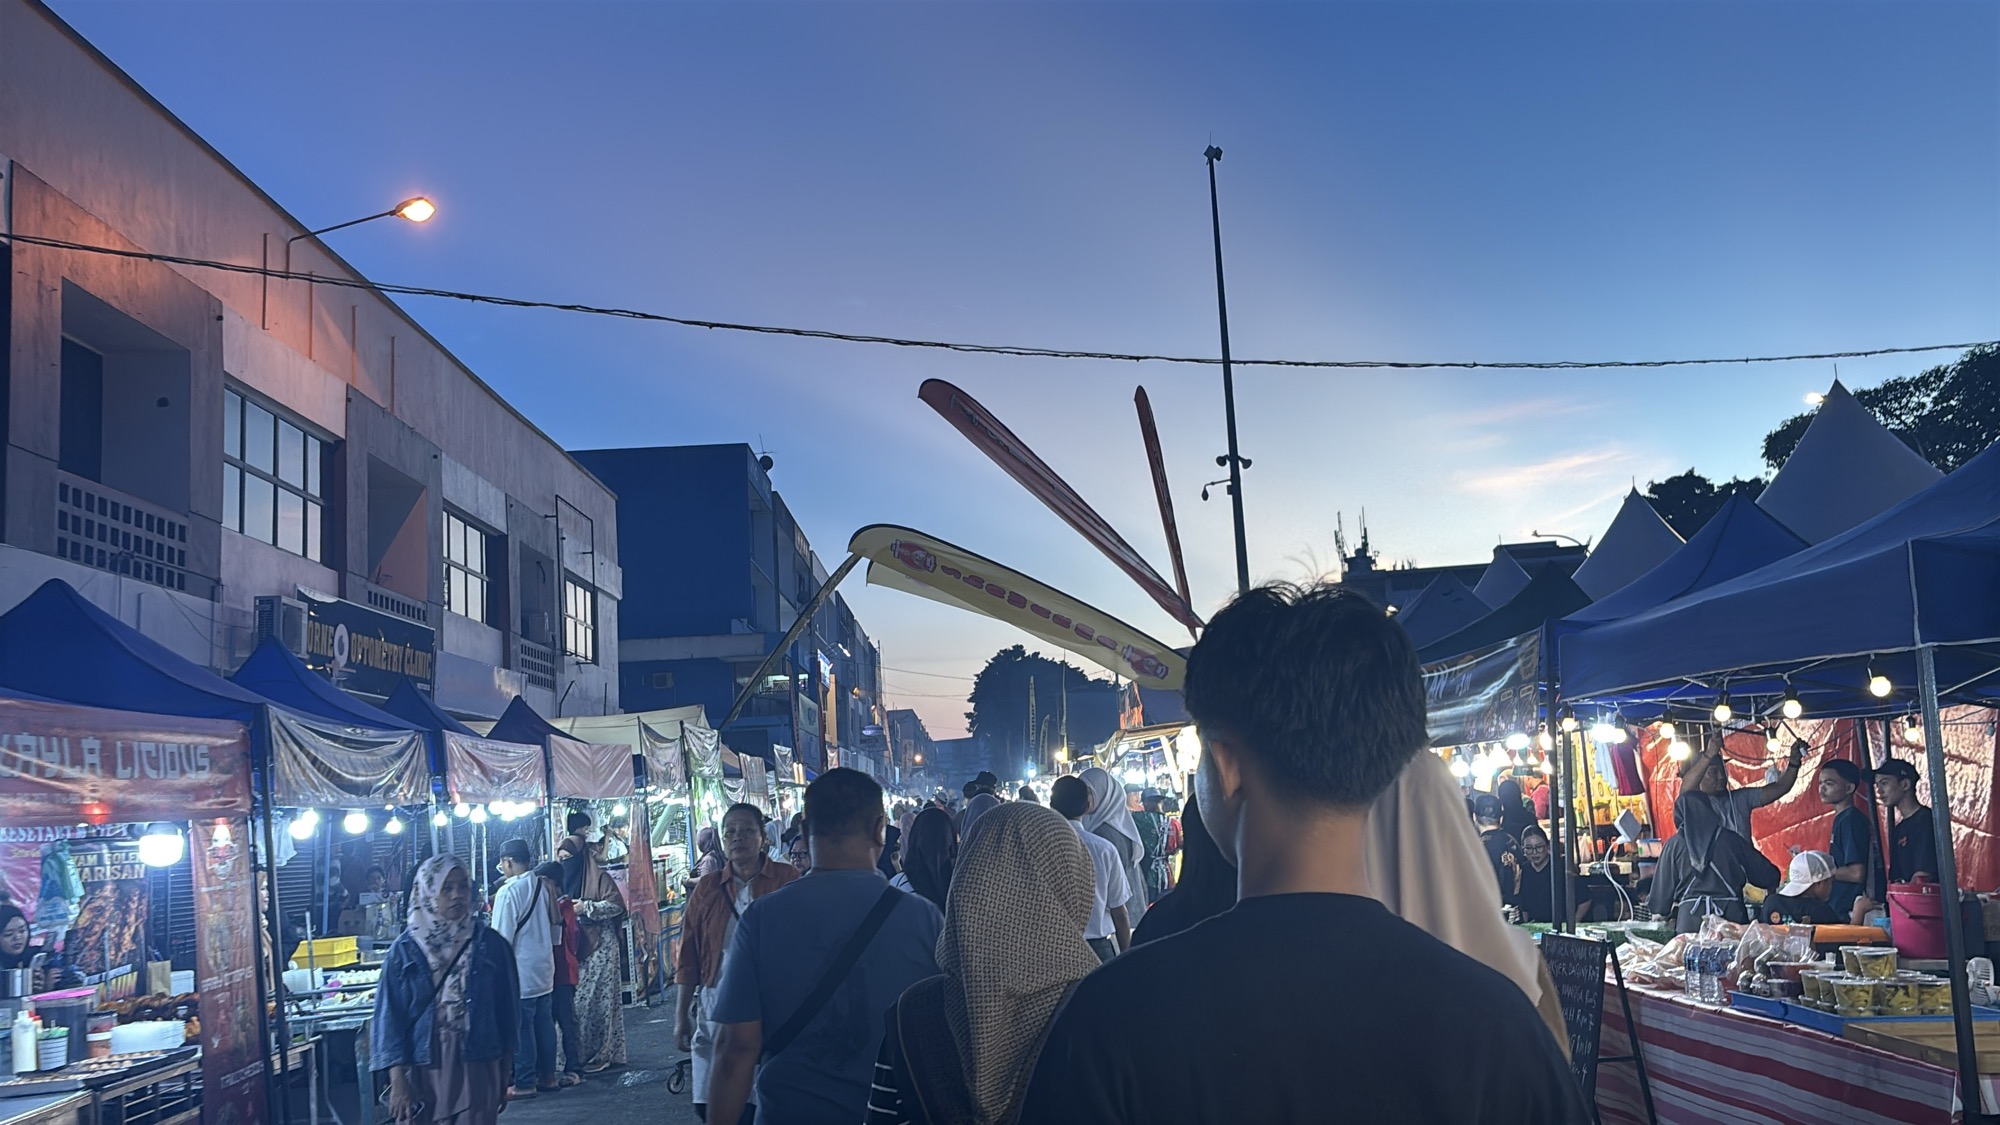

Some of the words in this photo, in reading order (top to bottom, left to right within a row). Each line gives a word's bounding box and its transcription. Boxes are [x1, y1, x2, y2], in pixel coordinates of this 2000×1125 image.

[307, 620, 349, 668] ORNEO
[351, 632, 404, 673] OPTOMETRY
[404, 647, 432, 680] CLINIC
[116, 740, 211, 779] LICIOUS
